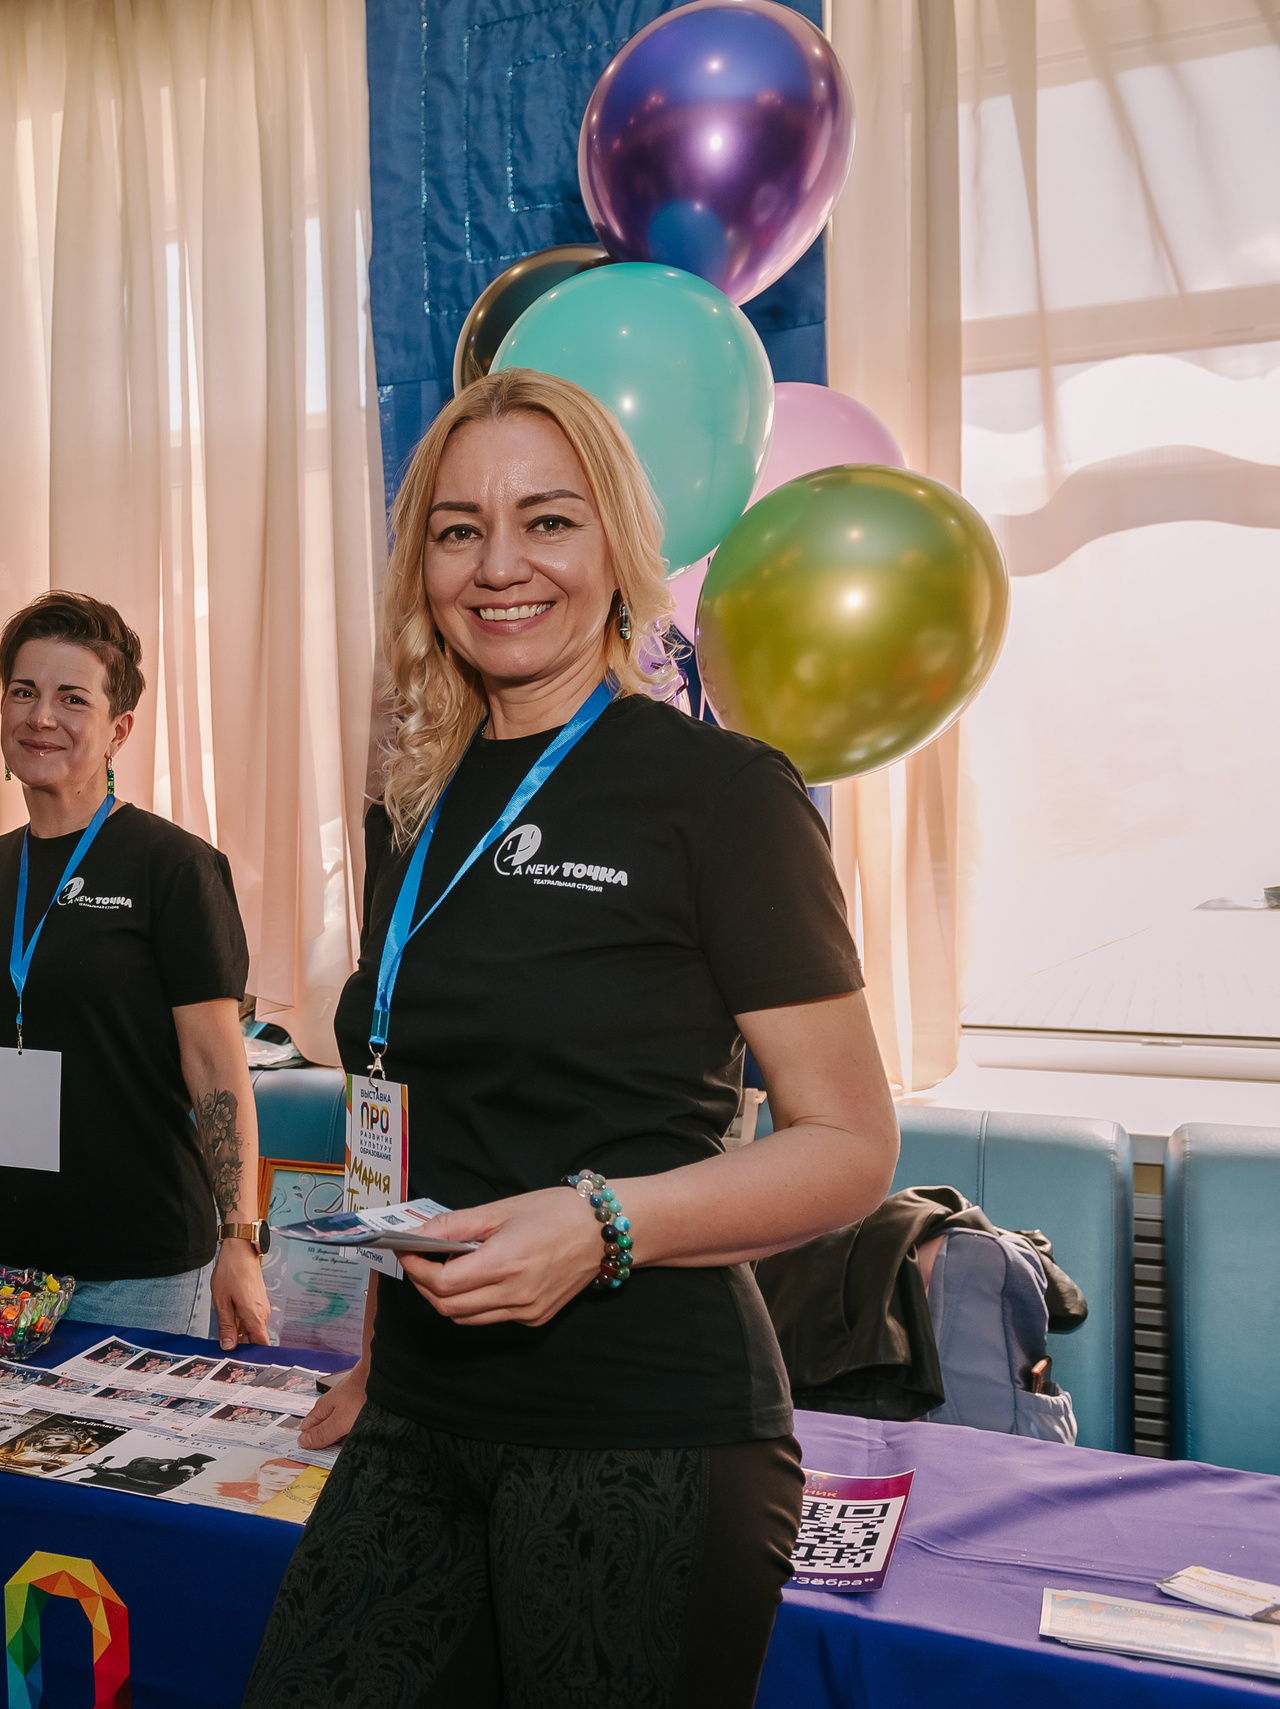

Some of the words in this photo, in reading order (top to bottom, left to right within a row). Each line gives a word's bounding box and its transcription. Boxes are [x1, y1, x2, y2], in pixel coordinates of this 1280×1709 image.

[513, 865, 523, 876] A
[525, 864, 560, 876] NEW
[561, 861, 628, 886] ТОЧКА
[533, 878, 576, 889] ТЕАТРАЛЬНАЯ
[576, 883, 603, 893] СТУДИЯ
[74, 895, 94, 904] NEW
[95, 896, 132, 909] ТОЧКА
[360, 1088, 392, 1103] ВЫСТАВКА
[360, 1101, 389, 1134] ПРО
[360, 1130, 393, 1145] РАЗВИТИЕ
[360, 1138, 392, 1153] КУЛЬТУРУ
[360, 1148, 392, 1162] ОБРАЗОВАНИЕ
[355, 1247, 384, 1264] УЧАСТНИК
